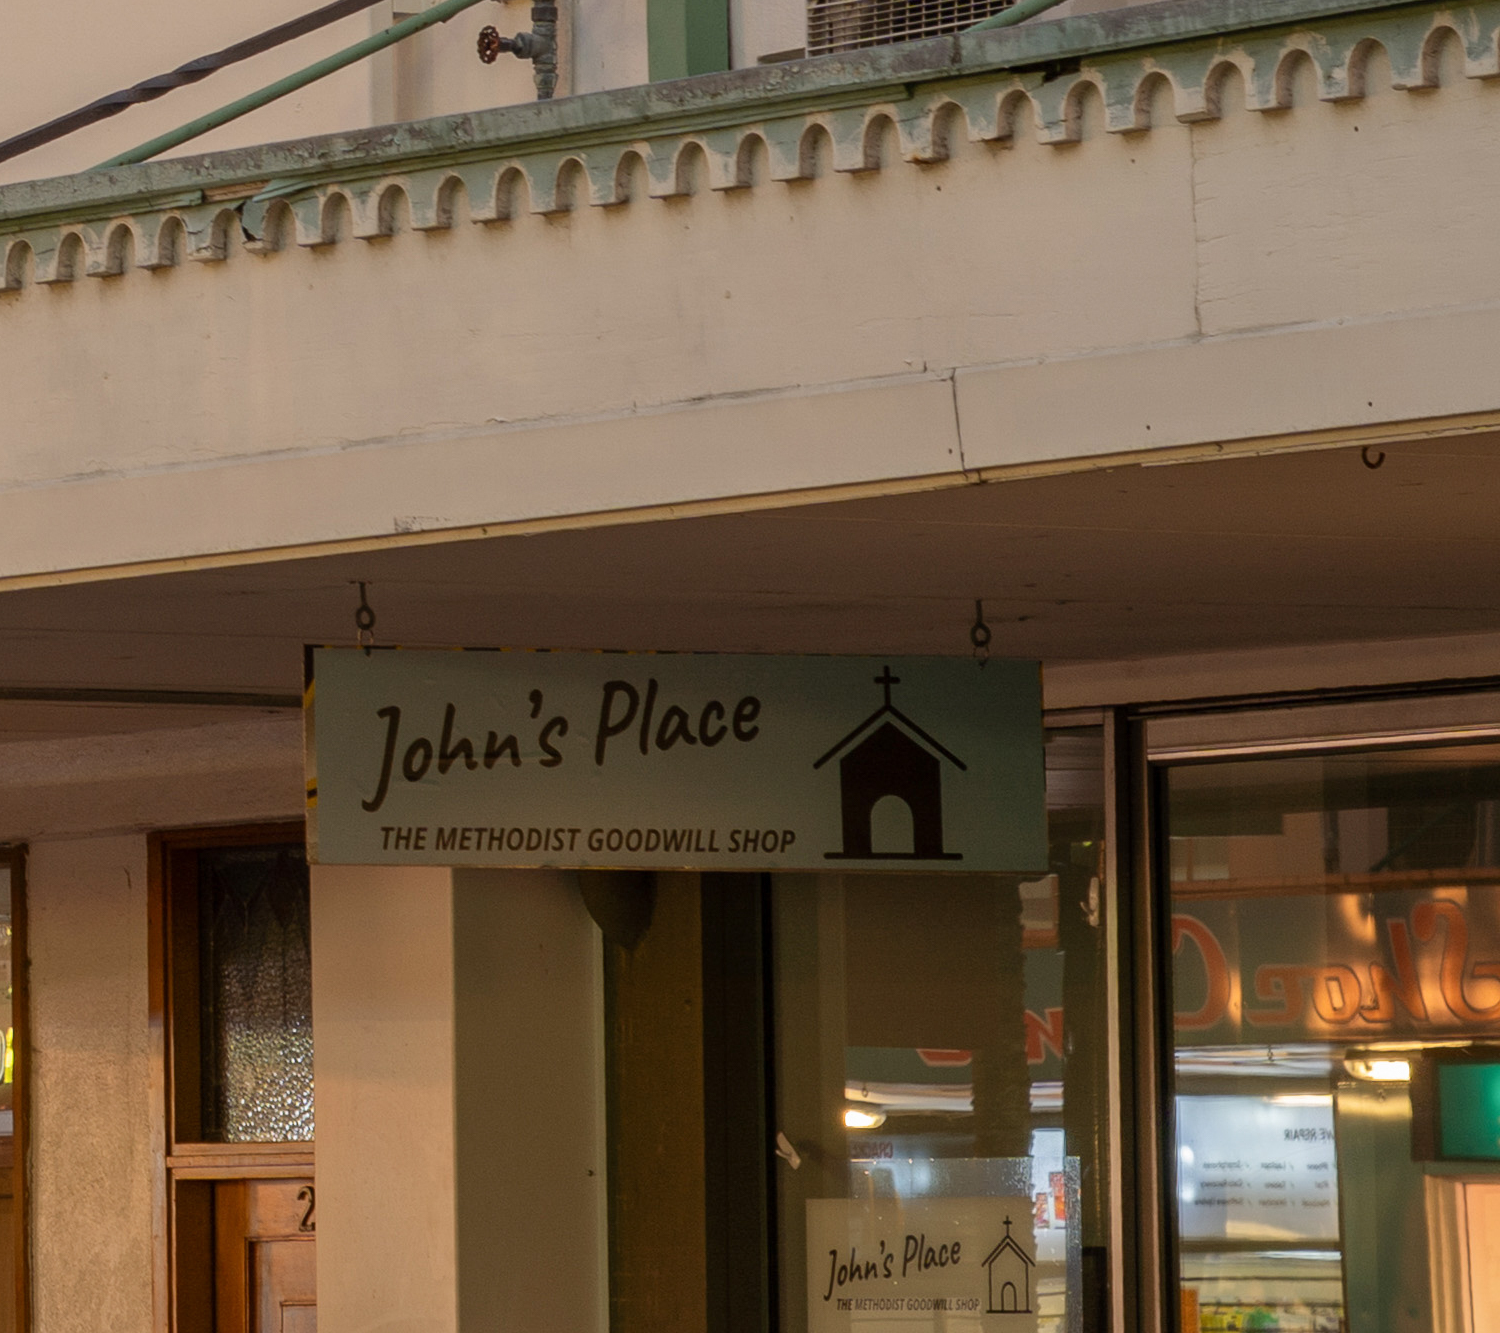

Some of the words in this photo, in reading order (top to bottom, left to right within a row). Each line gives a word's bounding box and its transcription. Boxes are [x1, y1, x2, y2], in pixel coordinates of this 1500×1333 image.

[361, 689, 569, 811] John's
[592, 679, 761, 767] Place
[381, 827, 428, 853] THE
[435, 826, 582, 853] METHODIST
[588, 828, 721, 854] GOODWILL
[728, 829, 796, 855] SHOP
[824, 1240, 894, 1301] John's
[903, 1234, 961, 1277] Place
[837, 1298, 852, 1311] THE
[855, 1298, 905, 1311] METHODIST
[907, 1298, 953, 1311] GOODWILL
[956, 1298, 980, 1311] SHOP
